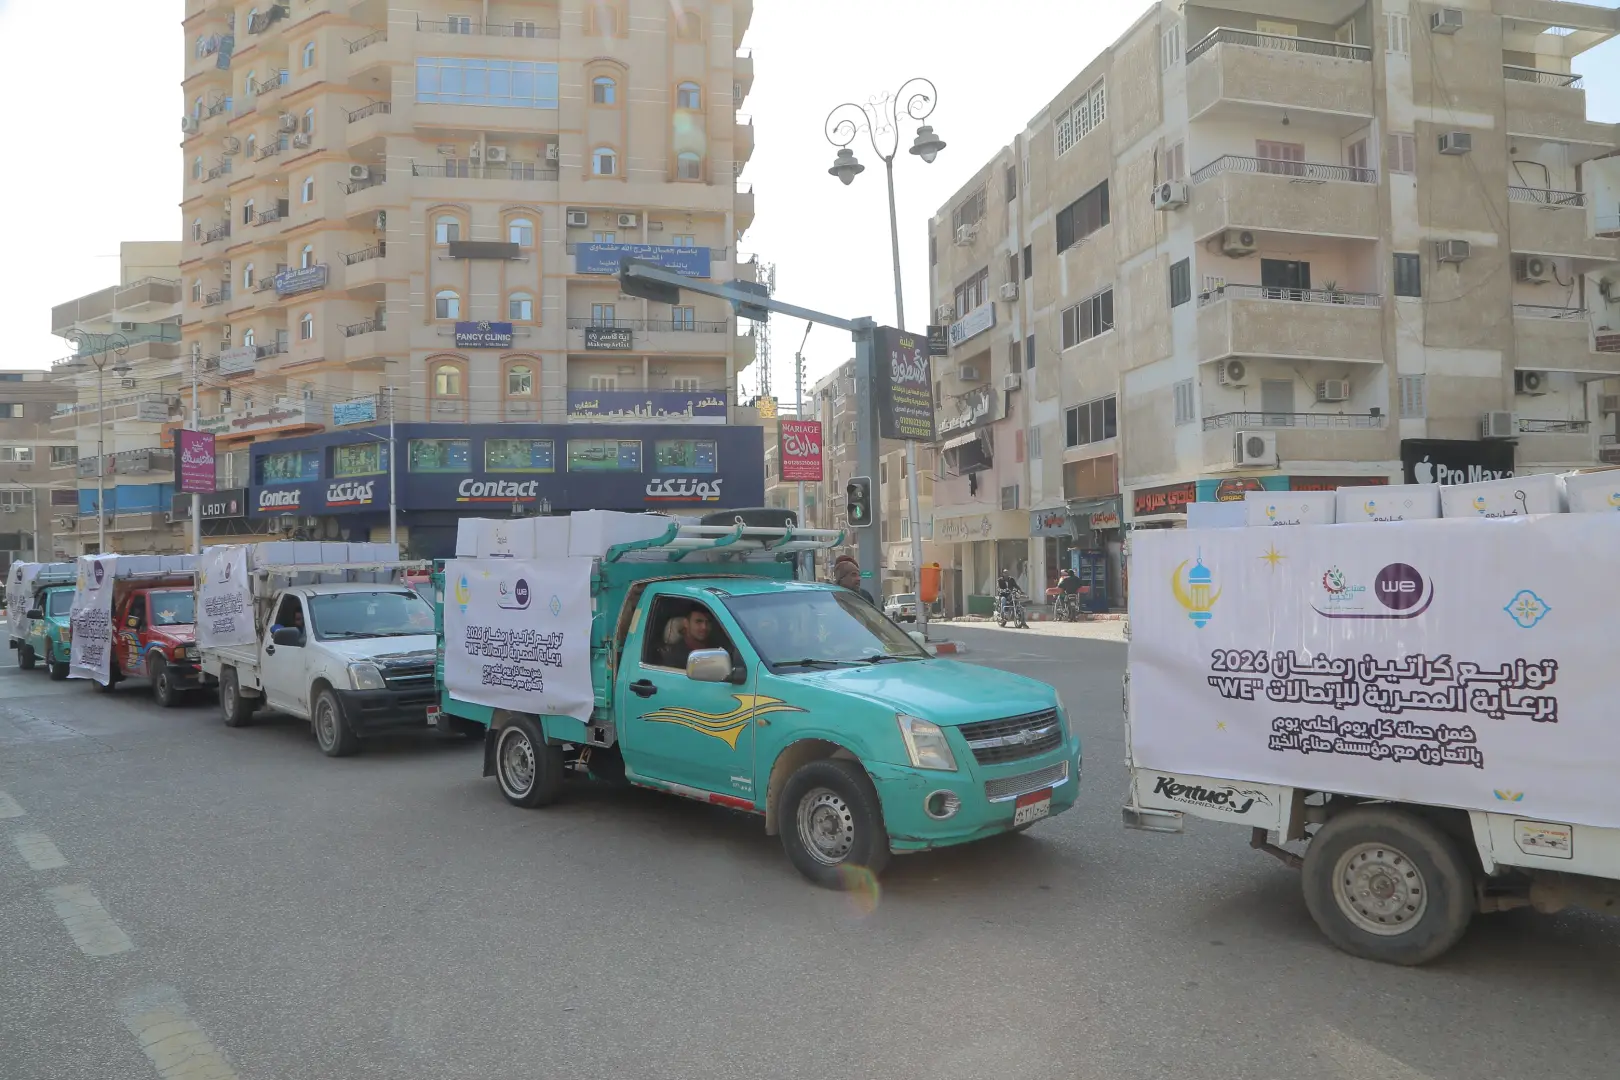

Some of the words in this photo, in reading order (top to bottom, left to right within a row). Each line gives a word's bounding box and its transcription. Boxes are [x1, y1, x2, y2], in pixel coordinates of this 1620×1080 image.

[677, 247, 697, 256] باسم
[456, 333, 483, 341] FANCY
[484, 333, 511, 341] CLINIC
[695, 397, 725, 408] دكتور
[782, 423, 820, 434] MARIAGE
[1437, 463, 1465, 486] Pro
[1468, 465, 1504, 483] Max
[326, 481, 375, 504] كونتكت
[458, 478, 539, 498] Contact
[645, 478, 723, 501] كونتكت
[259, 489, 301, 507] Contact
[202, 503, 226, 516] LADY
[1382, 580, 1416, 593] we
[467, 626, 482, 639] 2026
[483, 627, 508, 644] رمضان
[535, 632, 563, 650] توزيع
[1211, 648, 1270, 673] 2026
[1272, 650, 1356, 682] رمضان
[1358, 653, 1455, 685] كراتين
[1457, 657, 1559, 690] توزيع
[1363, 684, 1467, 714] المصرية
[1470, 686, 1558, 723] برعاية
[1272, 716, 1302, 734] يوم
[1300, 714, 1339, 733] أحلى
[1338, 721, 1371, 739] يوم
[1369, 718, 1396, 740] كل
[1395, 720, 1436, 740] حملة
[1268, 733, 1301, 752] الخير
[1436, 723, 1477, 745] ضمن
[1300, 734, 1333, 754] صناع
[1333, 737, 1392, 761] مؤسسة
[1392, 745, 1418, 763] مع
[1418, 744, 1484, 769] بالتعاون
[1173, 796, 1234, 813] UNBRIDLED
